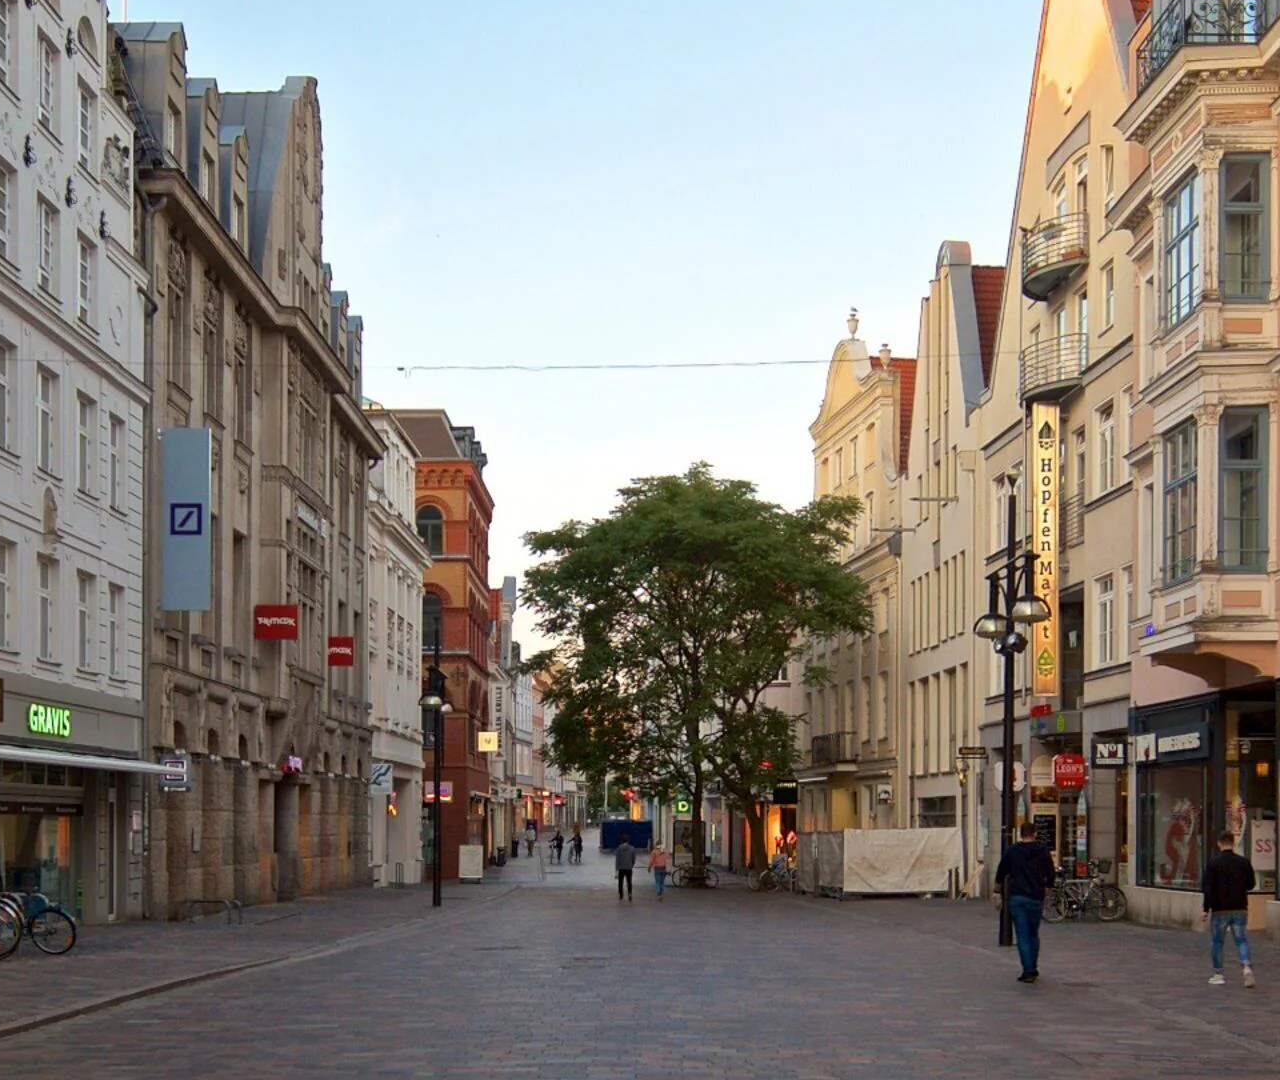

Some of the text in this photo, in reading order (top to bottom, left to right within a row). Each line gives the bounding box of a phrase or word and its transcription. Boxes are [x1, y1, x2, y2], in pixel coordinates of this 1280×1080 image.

[1039, 458, 1053, 639] Hopfen Mart
[29, 703, 70, 738] GRAVIS
[1256, 839, 1274, 852] SS
